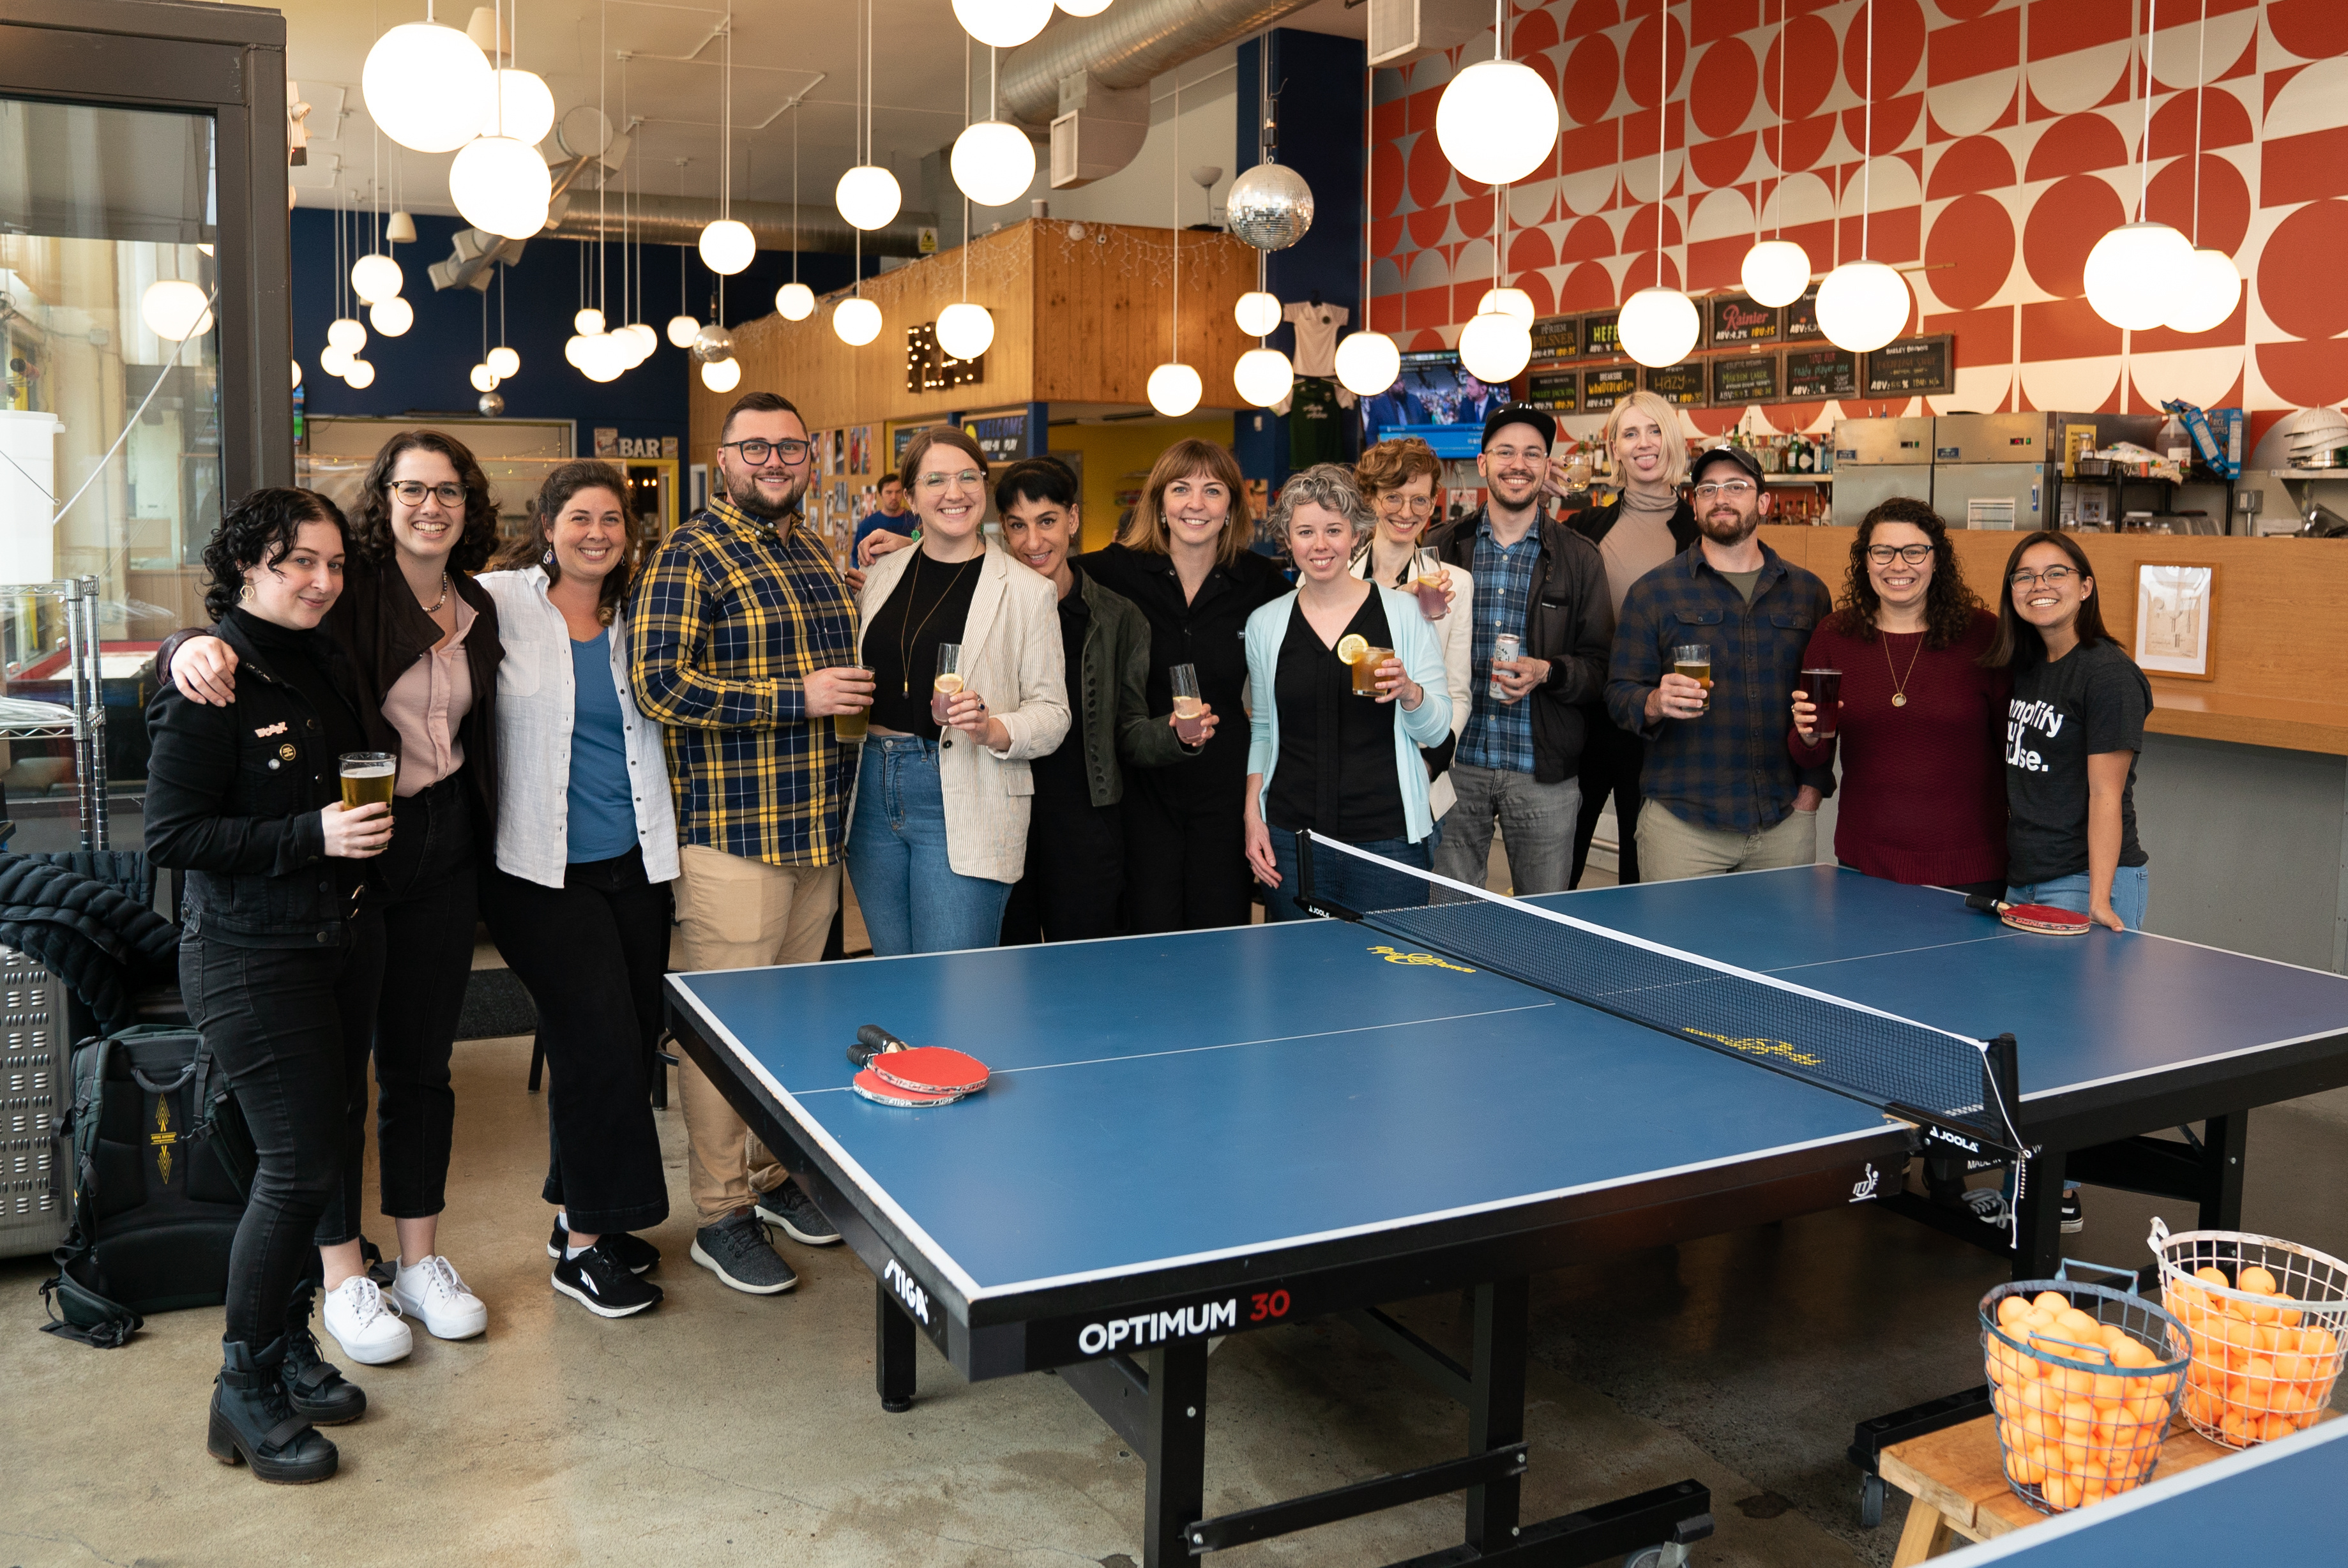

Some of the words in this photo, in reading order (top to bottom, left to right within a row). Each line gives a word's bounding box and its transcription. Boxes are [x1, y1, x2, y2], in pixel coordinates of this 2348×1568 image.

[1722, 304, 1769, 331] Rainier
[1533, 331, 1575, 349] PILSNER
[1794, 364, 1811, 377] ready
[1815, 365, 1835, 378] player
[1837, 364, 1849, 373] one
[977, 416, 1025, 439] WELCOME
[618, 437, 660, 458] BAR
[2008, 698, 2064, 737] mplify
[1939, 1133, 1979, 1153] JOOLA
[884, 1258, 929, 1324] STIGA
[1079, 1299, 1236, 1354] OPTIMUM
[1250, 1289, 1291, 1322] 30
